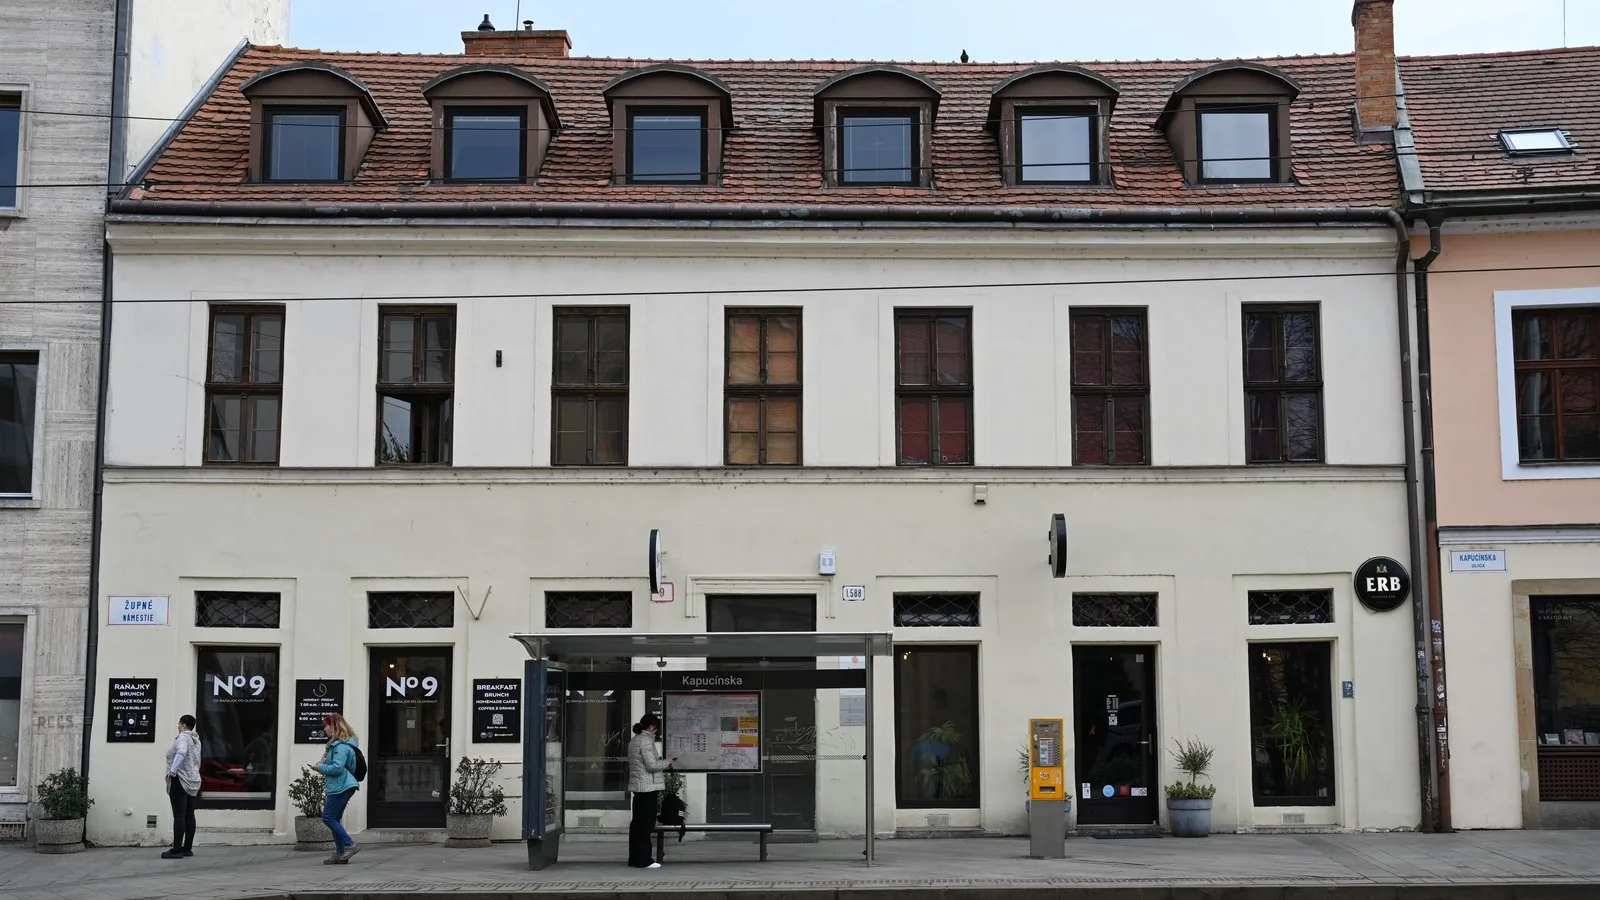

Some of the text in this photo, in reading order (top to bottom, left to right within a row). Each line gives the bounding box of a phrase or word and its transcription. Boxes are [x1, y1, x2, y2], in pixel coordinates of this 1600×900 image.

[1460, 553, 1496, 561] KAPUCÍNSKA
[1366, 576, 1401, 592] ERB
[124, 599, 153, 610] ŽUPNÉ
[122, 613, 154, 622] NÁMESTIE
[114, 682, 151, 690] RAŇAJKY
[682, 675, 743, 687] Kapucínska
